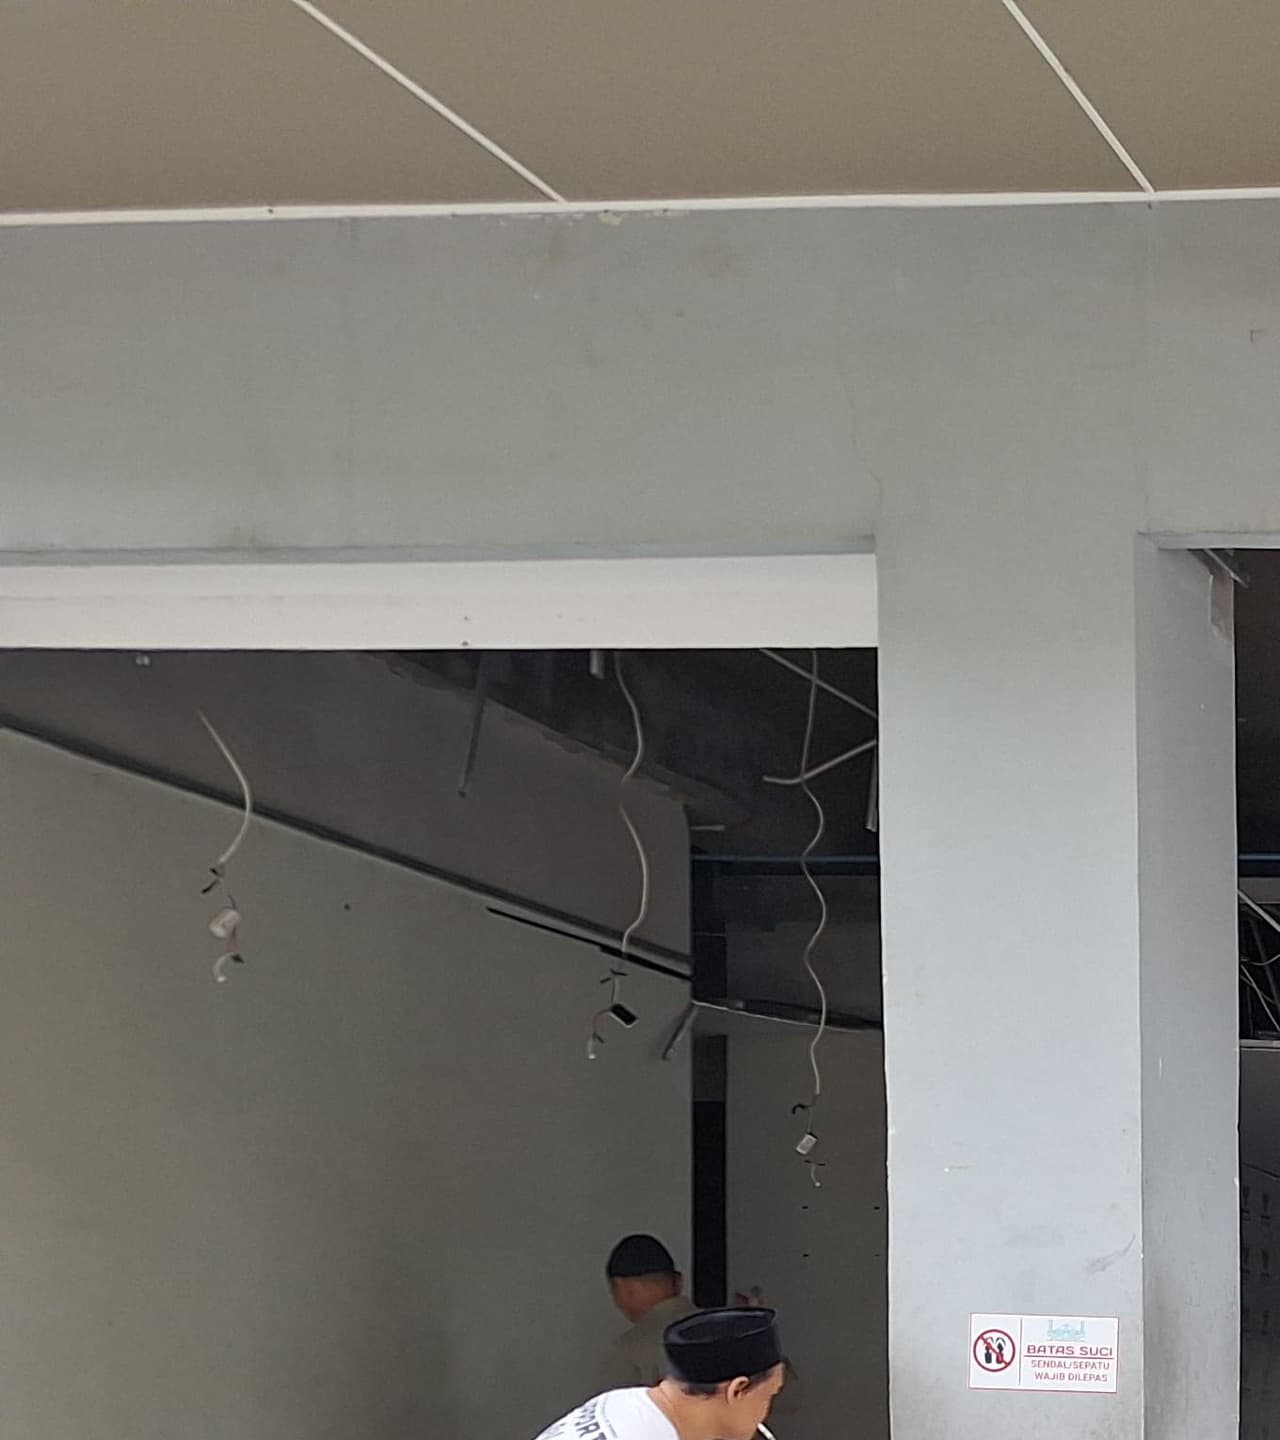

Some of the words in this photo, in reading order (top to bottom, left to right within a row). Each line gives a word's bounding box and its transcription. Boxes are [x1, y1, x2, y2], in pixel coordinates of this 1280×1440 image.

[1027, 1344, 1075, 1356] BATAS
[1079, 1345, 1113, 1357] SUCI
[1031, 1359, 1110, 1370] SENDAL/SEPATU
[1034, 1372, 1066, 1381] WAJIB
[1068, 1373, 1108, 1382] DILEPAS
